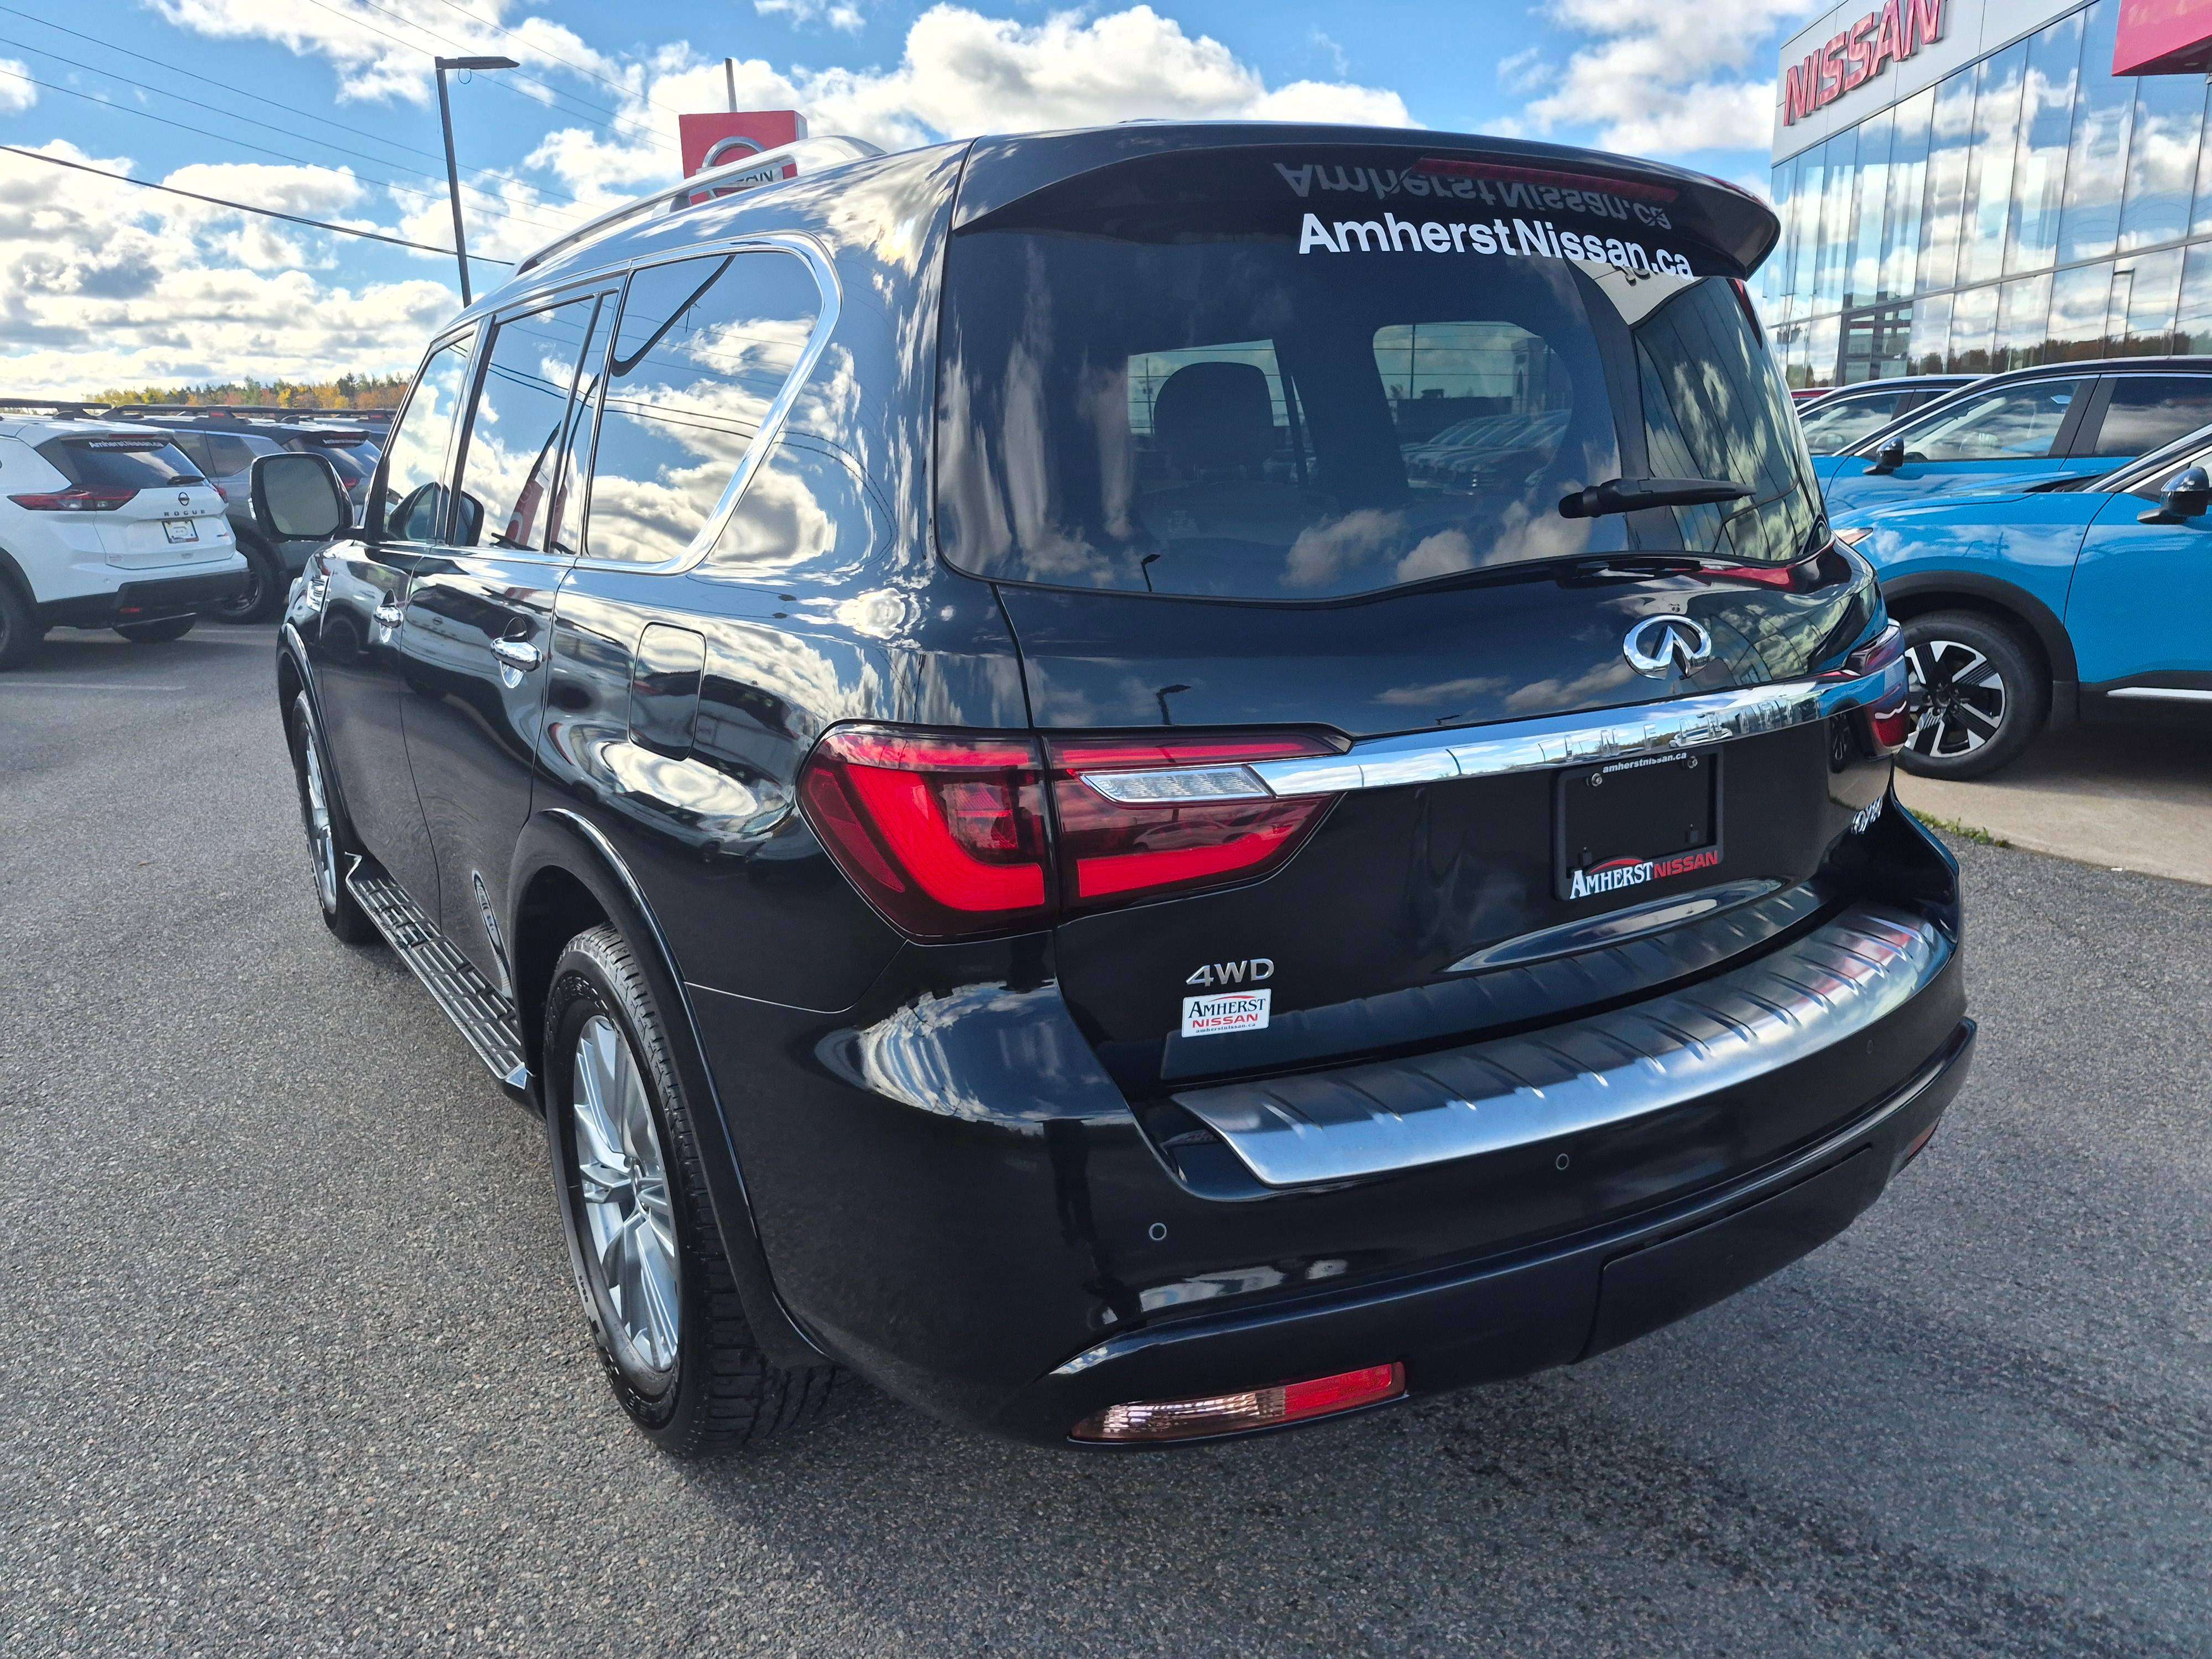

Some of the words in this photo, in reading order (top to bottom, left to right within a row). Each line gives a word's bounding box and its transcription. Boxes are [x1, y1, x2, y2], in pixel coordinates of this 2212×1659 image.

[1783, 0, 1942, 126] NISSAN
[1298, 212, 1694, 280] AmherstNissan.ca
[1603, 752, 1687, 773] amherstnissan.ca
[1569, 861, 1653, 899] AMHERST
[1653, 850, 1718, 878] NISSAN
[1186, 958, 1275, 987] 4WD
[1188, 998, 1266, 1018] AMHERST
[1192, 1013, 1258, 1028] NISSAN
